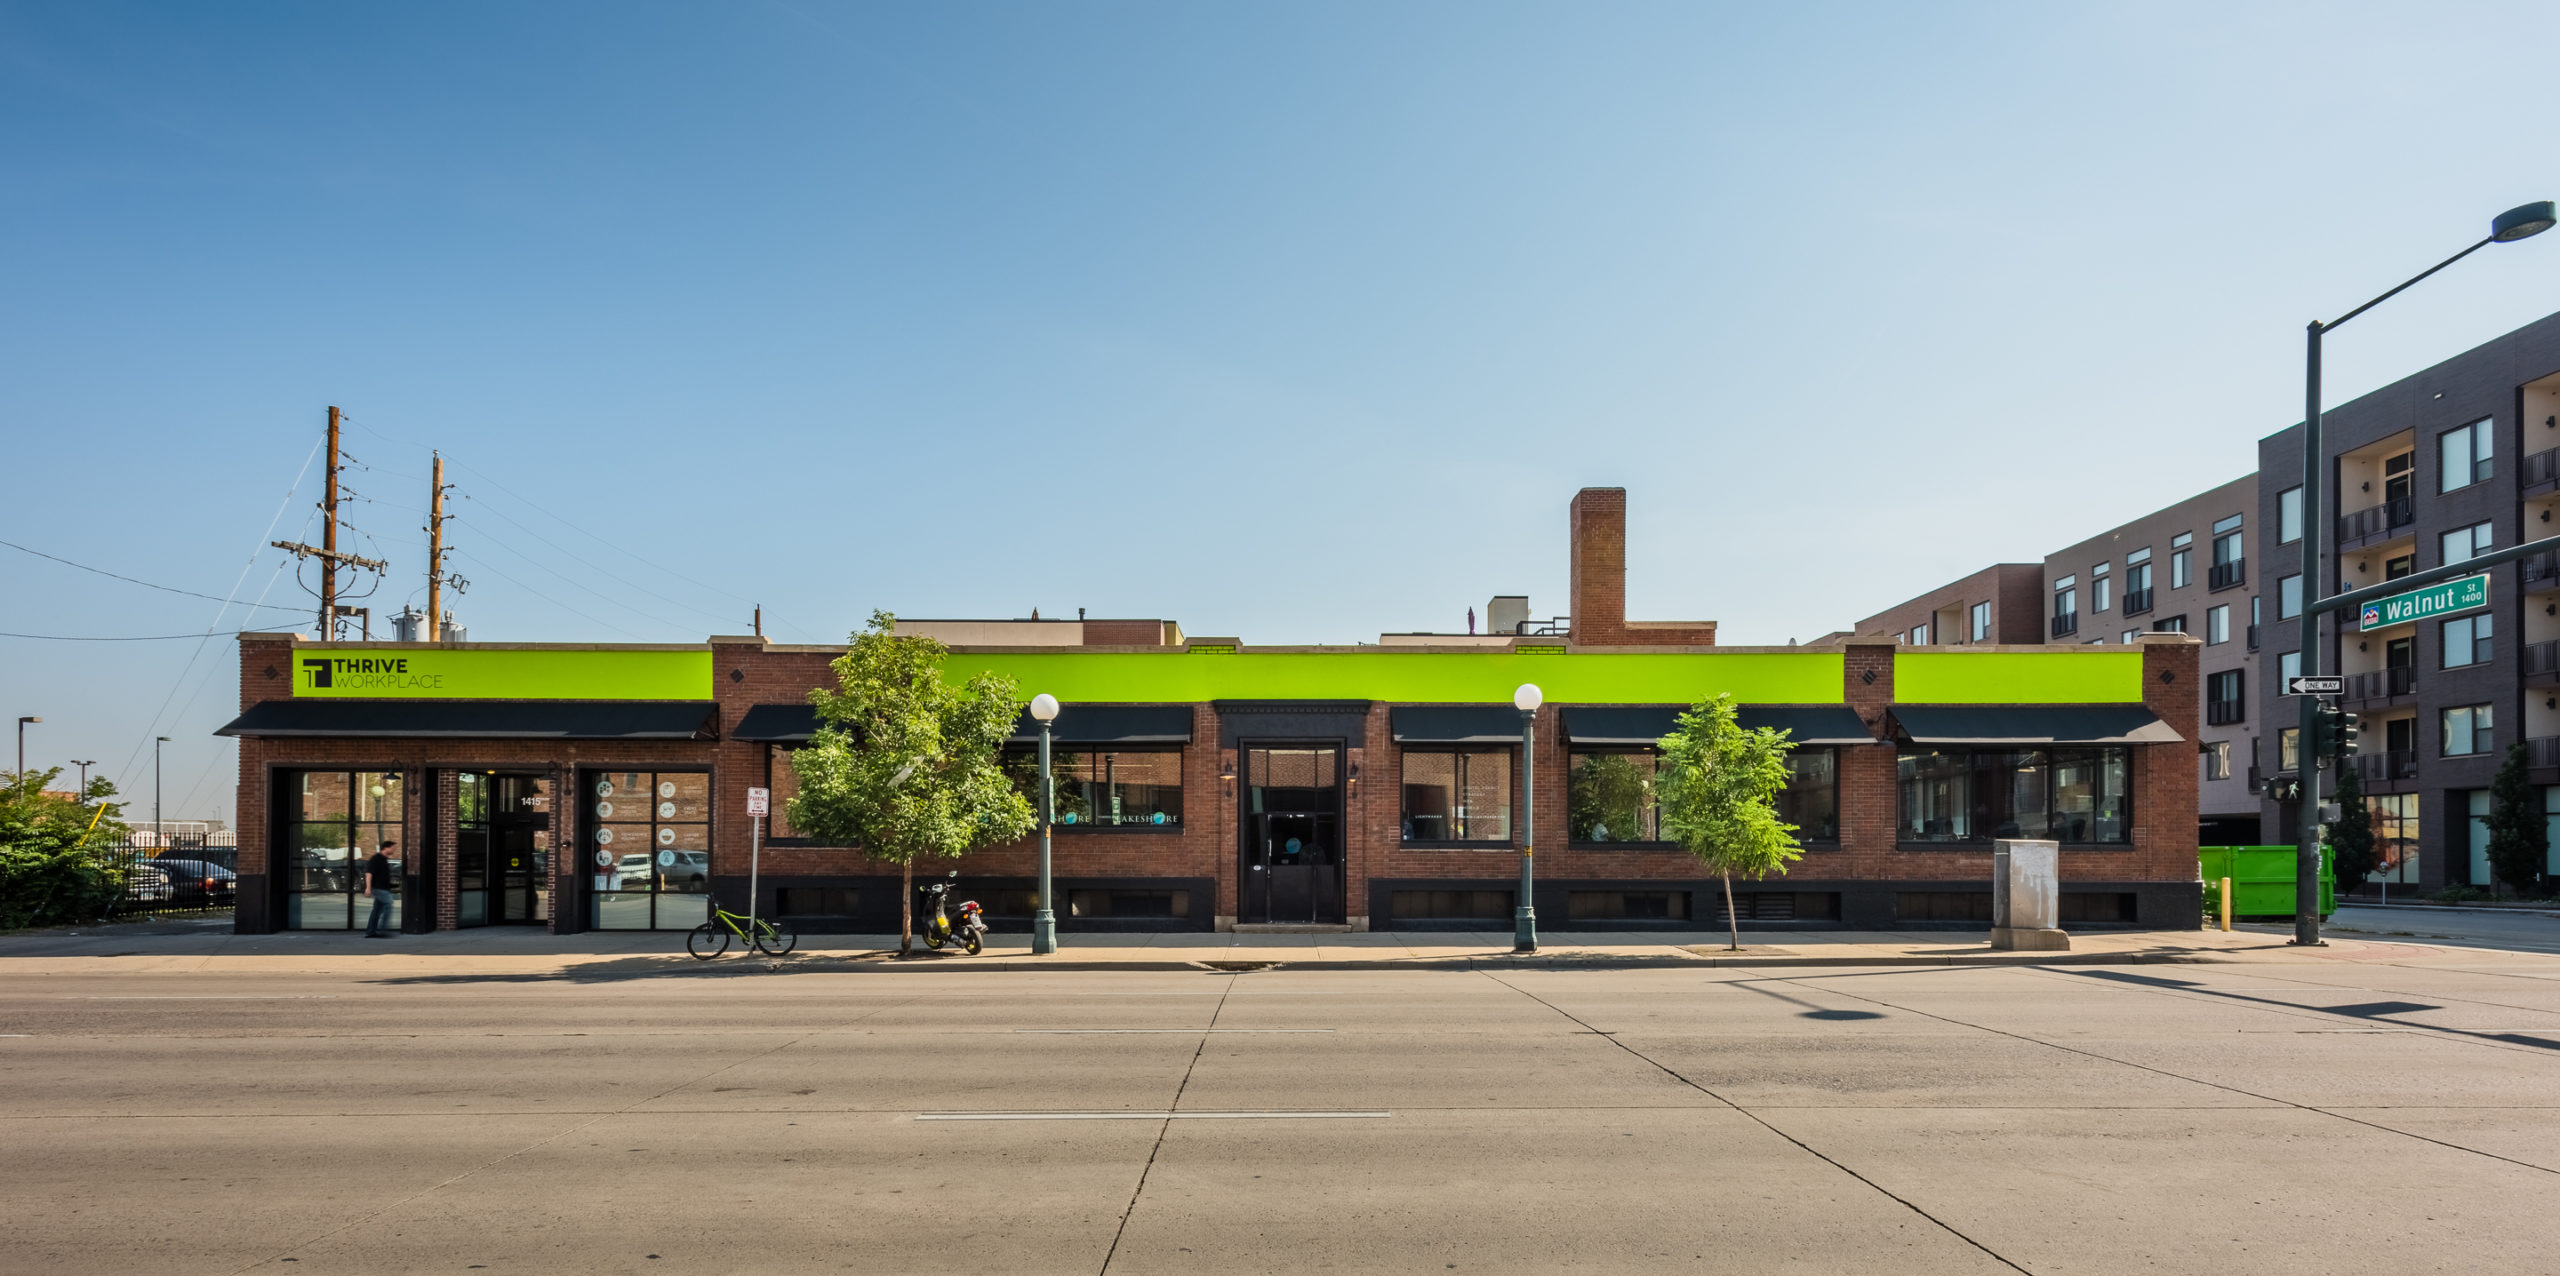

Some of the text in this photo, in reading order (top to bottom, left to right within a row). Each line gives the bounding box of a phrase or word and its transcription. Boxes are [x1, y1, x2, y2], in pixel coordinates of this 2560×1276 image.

[2467, 583, 2476, 593] St
[2461, 592, 2482, 603] 1400
[2387, 589, 2455, 620] Walnut
[334, 659, 408, 673] THRIVE
[334, 674, 443, 688] WORKPLACE
[2304, 681, 2337, 690] ONE WAY
[521, 797, 541, 806] 1415
